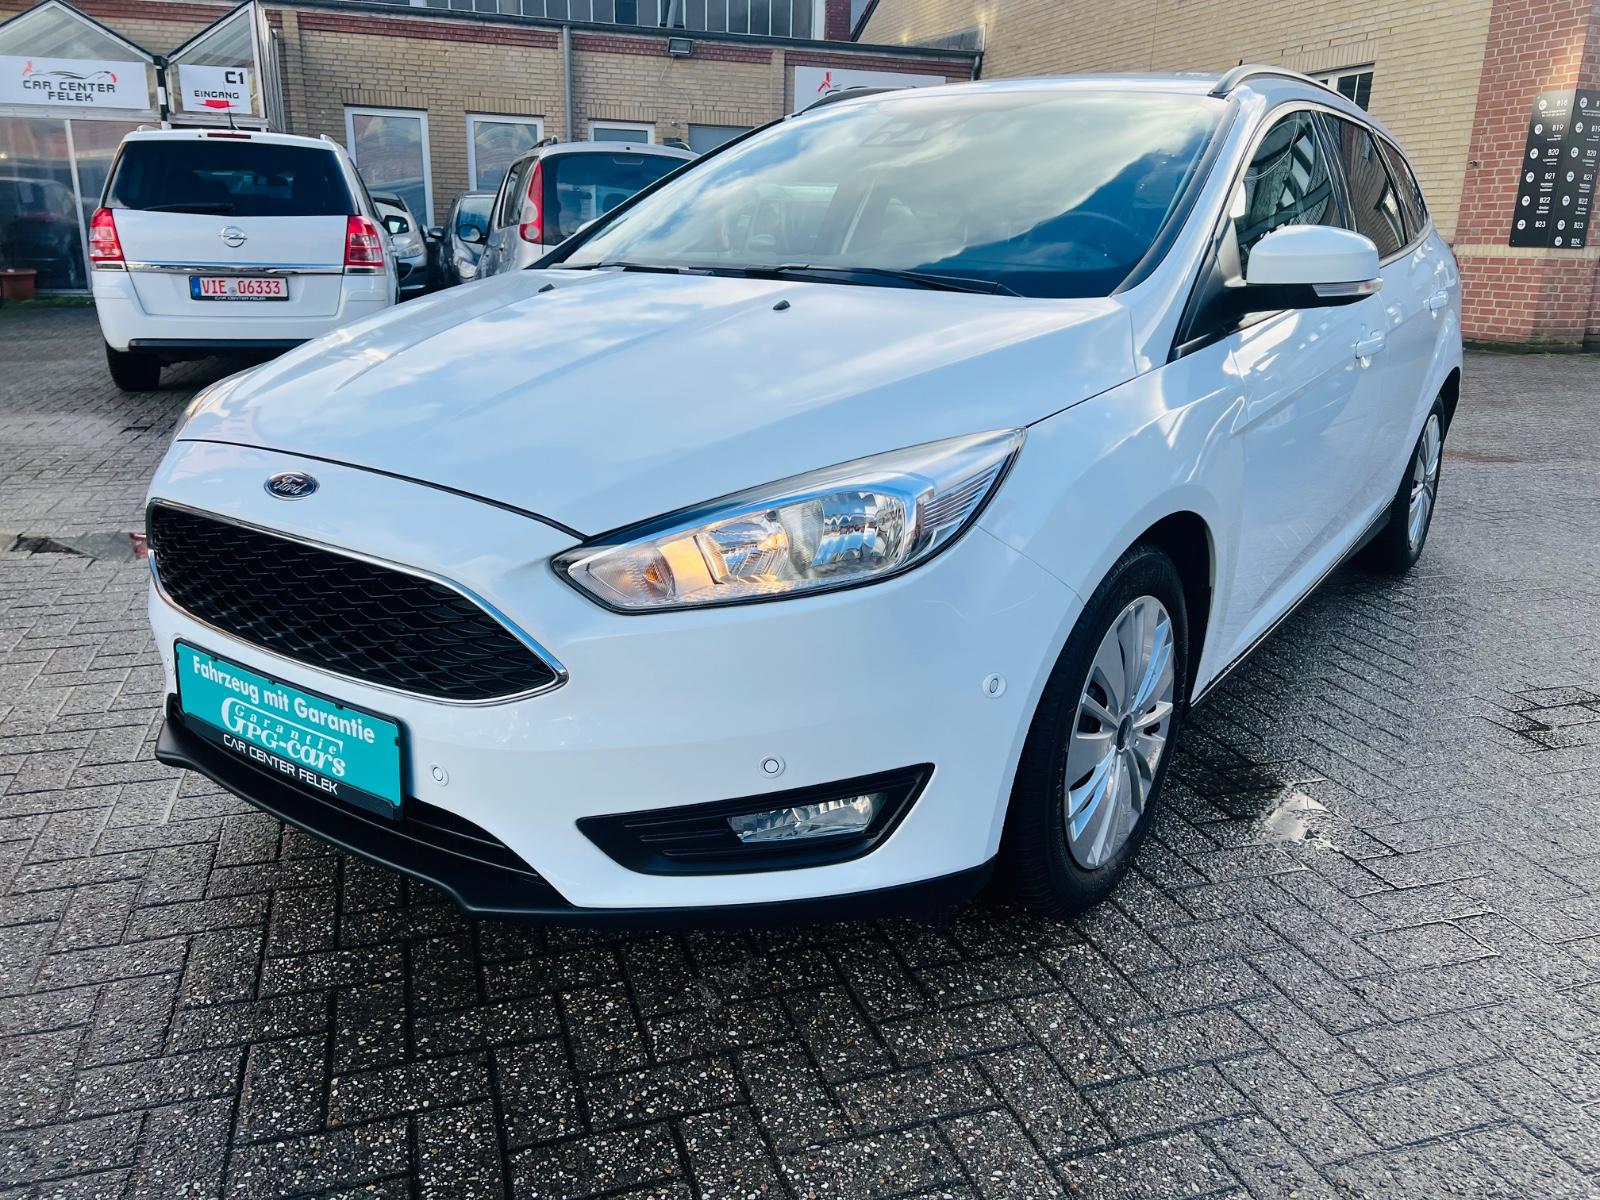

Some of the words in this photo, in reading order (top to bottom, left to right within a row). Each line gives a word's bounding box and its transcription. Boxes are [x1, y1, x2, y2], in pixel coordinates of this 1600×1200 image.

[224, 71, 245, 85] C1
[23, 79, 51, 90] CAR
[59, 81, 116, 93] CENTER
[48, 91, 94, 102] FELEK
[194, 90, 240, 99] EINGANG
[1552, 123, 1564, 131] B19
[1547, 148, 1560, 156] B20
[1586, 149, 1597, 157] B20
[1544, 172, 1556, 180] B21
[1539, 196, 1551, 204] B22
[1535, 220, 1546, 228] B23
[201, 279, 227, 294] VIE
[237, 280, 281, 295] 06333
[273, 475, 308, 494] Ford
[192, 655, 260, 704] Fahrzeug
[263, 688, 290, 713] mit
[293, 698, 376, 745] Garantie
[234, 704, 338, 756] Garantie
[221, 697, 347, 778] GPG-cars
[223, 733, 247, 755] CAR
[249, 744, 296, 777] CENTER
[299, 768, 338, 796] FELEK
